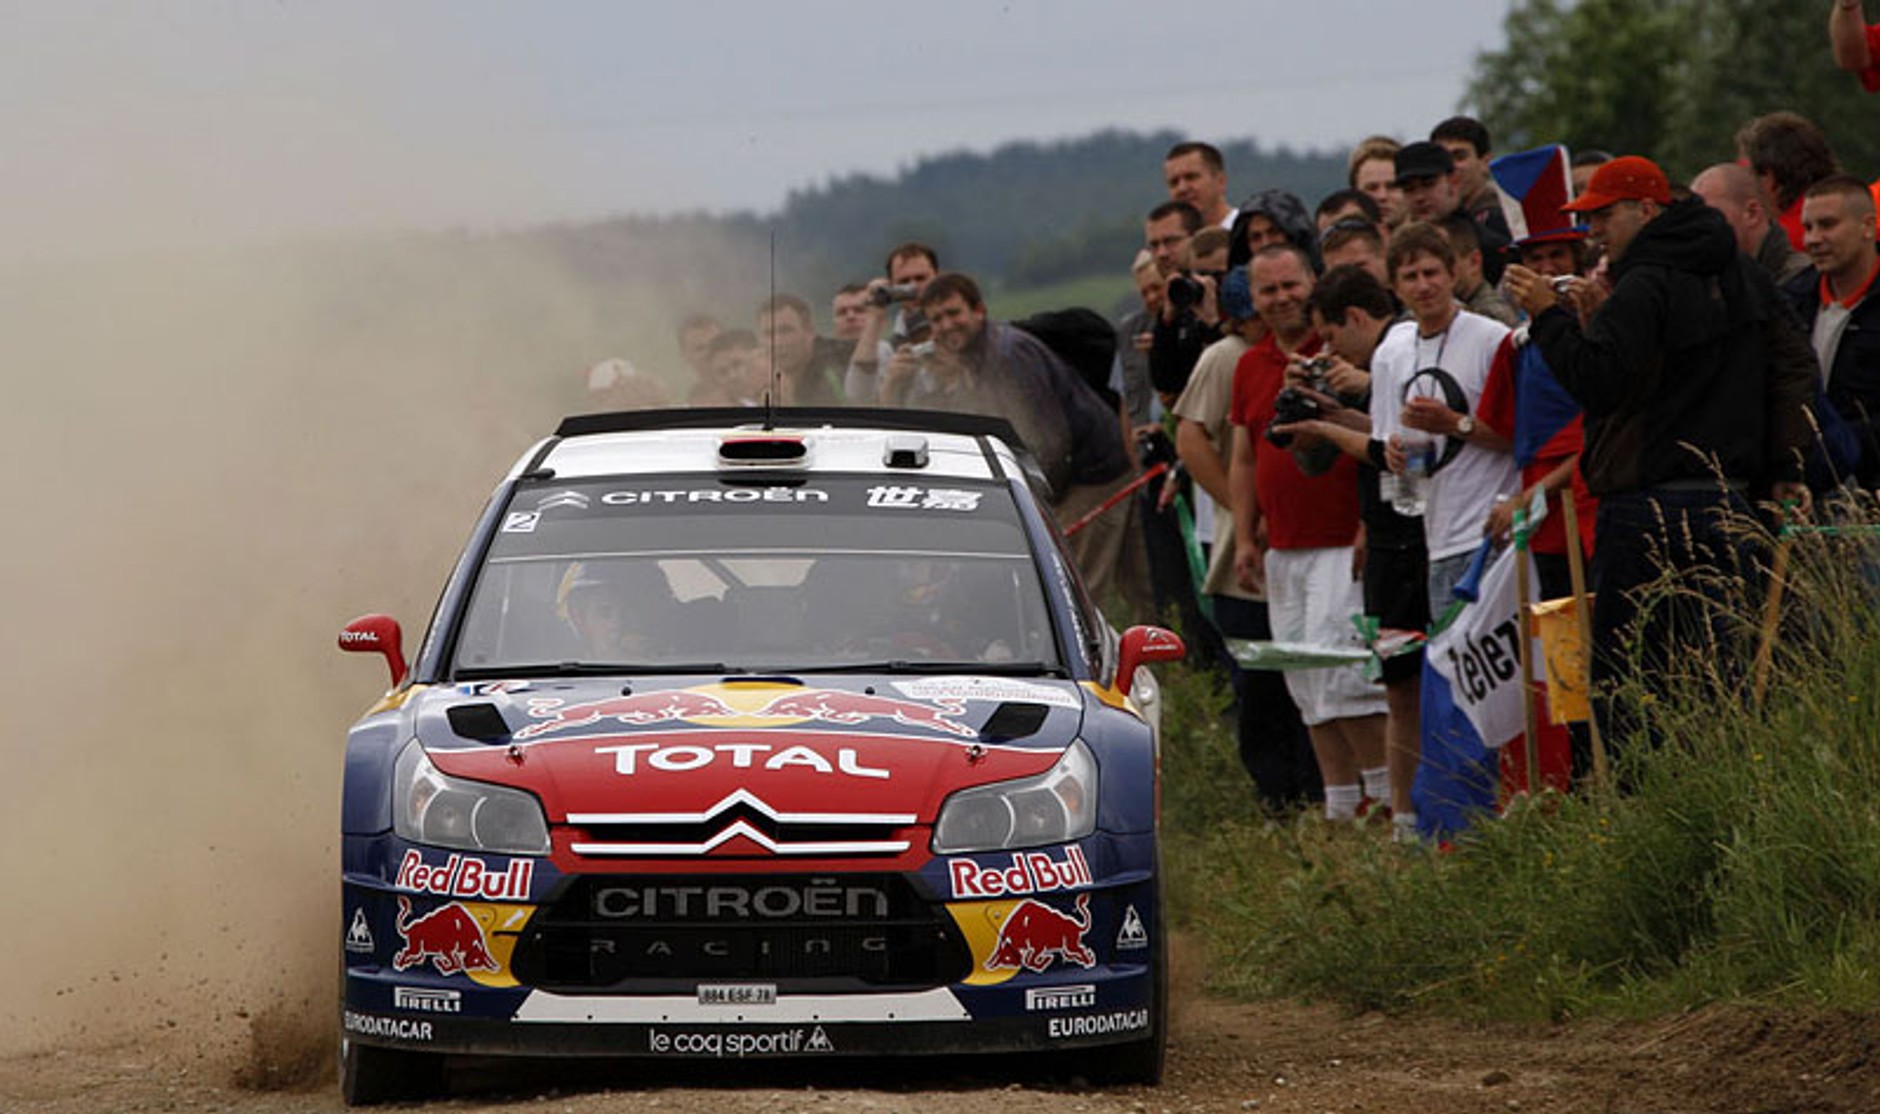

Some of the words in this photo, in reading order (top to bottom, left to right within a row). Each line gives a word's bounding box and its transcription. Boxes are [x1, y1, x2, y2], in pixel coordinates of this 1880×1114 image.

[507, 511, 537, 530] 2
[341, 630, 379, 643] TOTAL
[594, 743, 890, 779] TOTAL
[394, 986, 461, 1013] PIRELLI
[1025, 984, 1096, 1010] PIRELLI
[1049, 1008, 1149, 1038] EURODATACAR
[649, 1028, 671, 1052] le
[674, 1033, 723, 1058] coq
[725, 1028, 804, 1058] sportif
